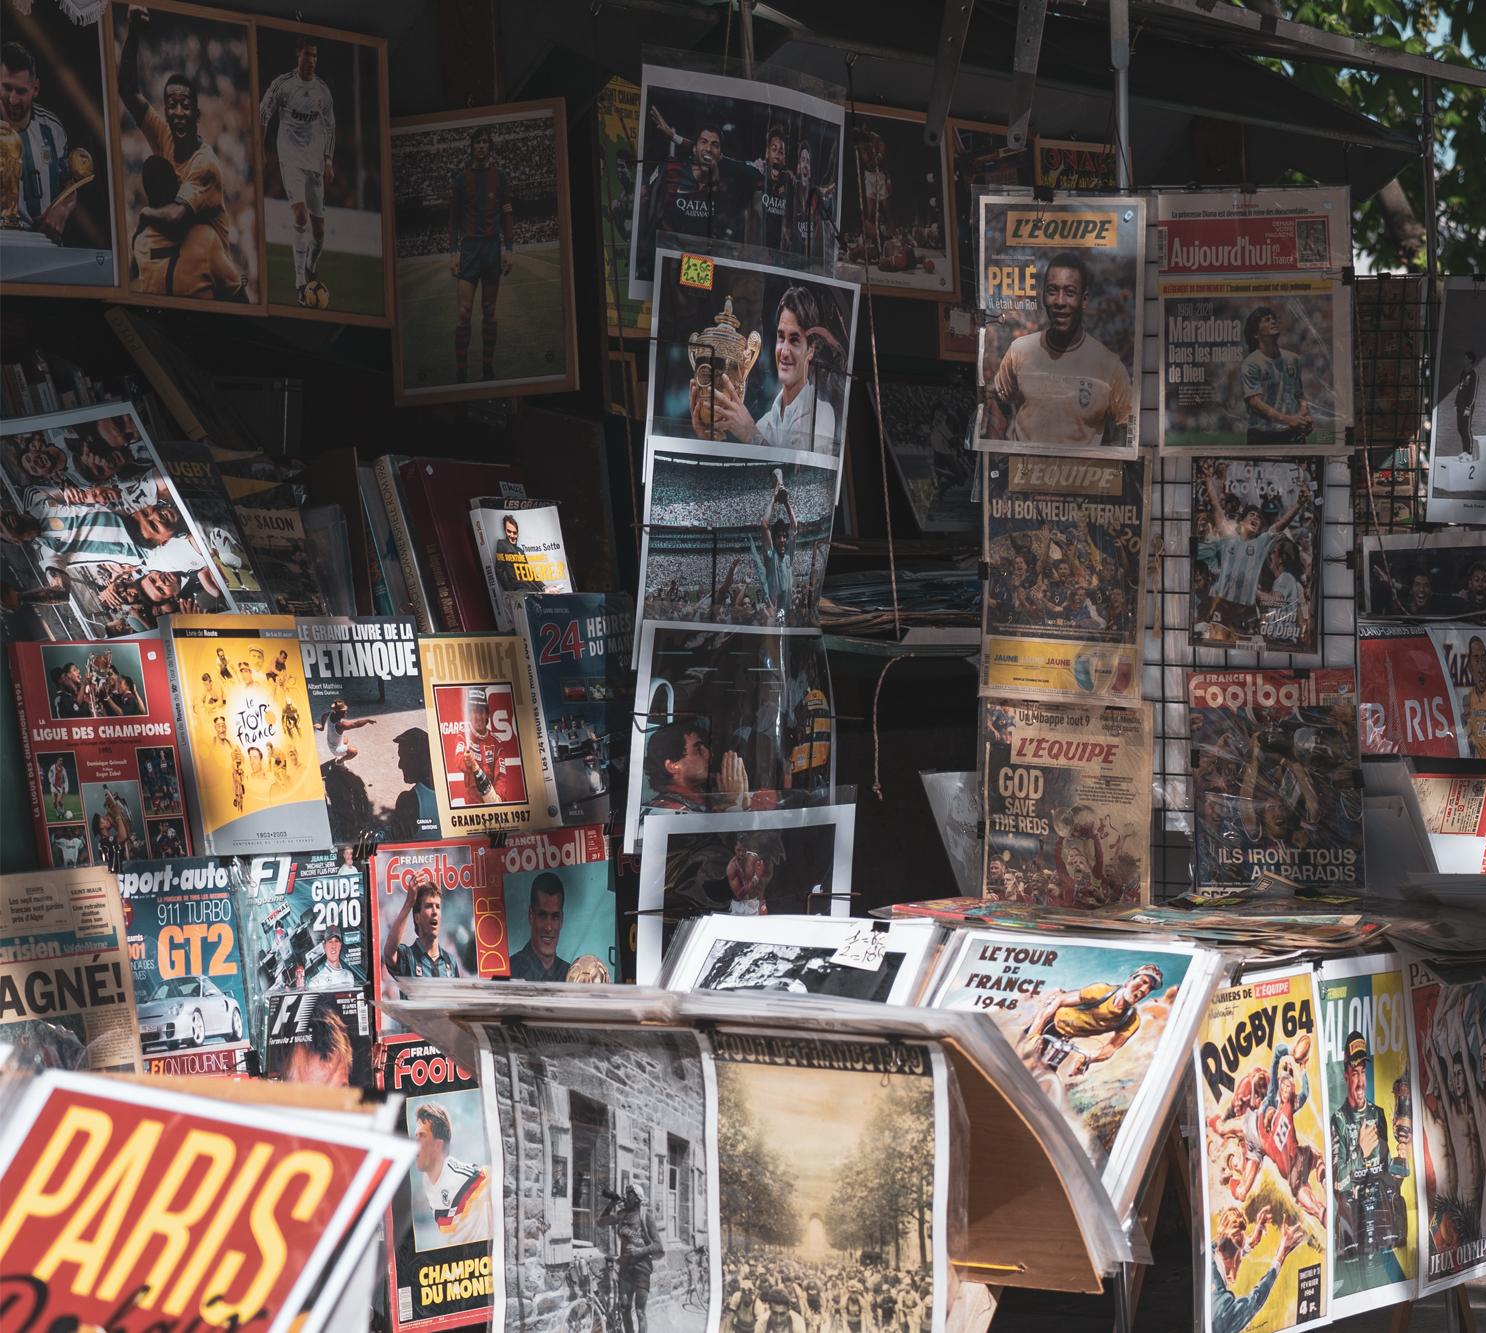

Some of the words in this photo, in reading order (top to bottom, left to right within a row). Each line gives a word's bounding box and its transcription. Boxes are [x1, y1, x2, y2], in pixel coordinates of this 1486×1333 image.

[292, 109, 321, 120] bwin
[1012, 218, 1112, 241] L'ÉQUIPE
[1170, 236, 1272, 270] Aujourd'hui
[988, 265, 1037, 297] PELÉ
[995, 298, 1013, 310] était
[1014, 301, 1024, 310] un
[1026, 300, 1037, 311] Roi
[1169, 317, 1241, 343] Maradona
[1169, 345, 1193, 363] Dans
[1195, 344, 1211, 363] les
[1213, 345, 1244, 363] mains
[1169, 365, 1181, 383] de
[1183, 364, 1205, 383] Dieu
[1468, 465, 1476, 480] 2
[992, 499, 1012, 518] UN
[254, 514, 295, 531] SALON
[521, 543, 542, 552] Thomas
[542, 542, 561, 551] Sotto
[204, 630, 218, 638] Route
[298, 625, 309, 640] LE
[311, 624, 350, 641] GRAND
[352, 624, 382, 640] LIVRE
[384, 624, 399, 640] DE
[400, 623, 414, 639] LA
[1260, 623, 1273, 635] de
[540, 620, 586, 665] 24
[586, 616, 631, 637] HEURES
[589, 641, 604, 656] DU
[1045, 658, 1071, 667] JAUNE
[323, 682, 343, 690] Mathieu
[1206, 673, 1247, 683] FRANCE
[533, 706, 543, 738] Heures
[32, 727, 69, 742] LIGUE
[72, 726, 95, 738] DES
[98, 723, 172, 738] CHAMPIONS
[1016, 737, 1119, 764] L'ÉQUIPE
[999, 766, 1045, 801] GOD
[511, 810, 530, 823] 1987
[1005, 799, 1036, 818] SAVE
[994, 815, 1017, 832] THE
[1019, 817, 1049, 836] REDS
[504, 835, 537, 847] FRANCE
[400, 854, 435, 865] FRANCE
[1218, 848, 1243, 864] ILS
[1248, 848, 1300, 864] IRONT
[1308, 848, 1356, 865] TOUS
[1280, 866, 1356, 881] PARADIS
[312, 877, 360, 901] GUIDE
[8, 897, 20, 905] Les
[21, 896, 32, 905] sept
[157, 903, 180, 925] 911
[185, 899, 232, 923] TURBO
[313, 899, 361, 932] 2010
[157, 923, 238, 980] GT2
[978, 945, 1003, 962] LE
[1003, 947, 1058, 967] TOUR
[1002, 965, 1021, 974] DE
[964, 972, 1046, 996] FRANCE
[1212, 990, 1241, 1005] CAHIERS
[1243, 988, 1253, 999] DE
[1255, 981, 1289, 997] L'ÉQUIPE
[974, 995, 1019, 1011] 1948
[1322, 991, 1404, 1067] ALONSO
[1200, 1004, 1278, 1105] RUGBY
[1282, 999, 1314, 1038] 64
[151, 1060, 165, 1075] F1
[165, 1058, 180, 1076] ON
[182, 1052, 229, 1074] TOURNE
[0, 1105, 333, 1329] PARIS
[1430, 1250, 1455, 1275] JEUX
[421, 1285, 443, 1306] DU
[1304, 1288, 1315, 1297] 1964
[1299, 1300, 1308, 1315] 4
